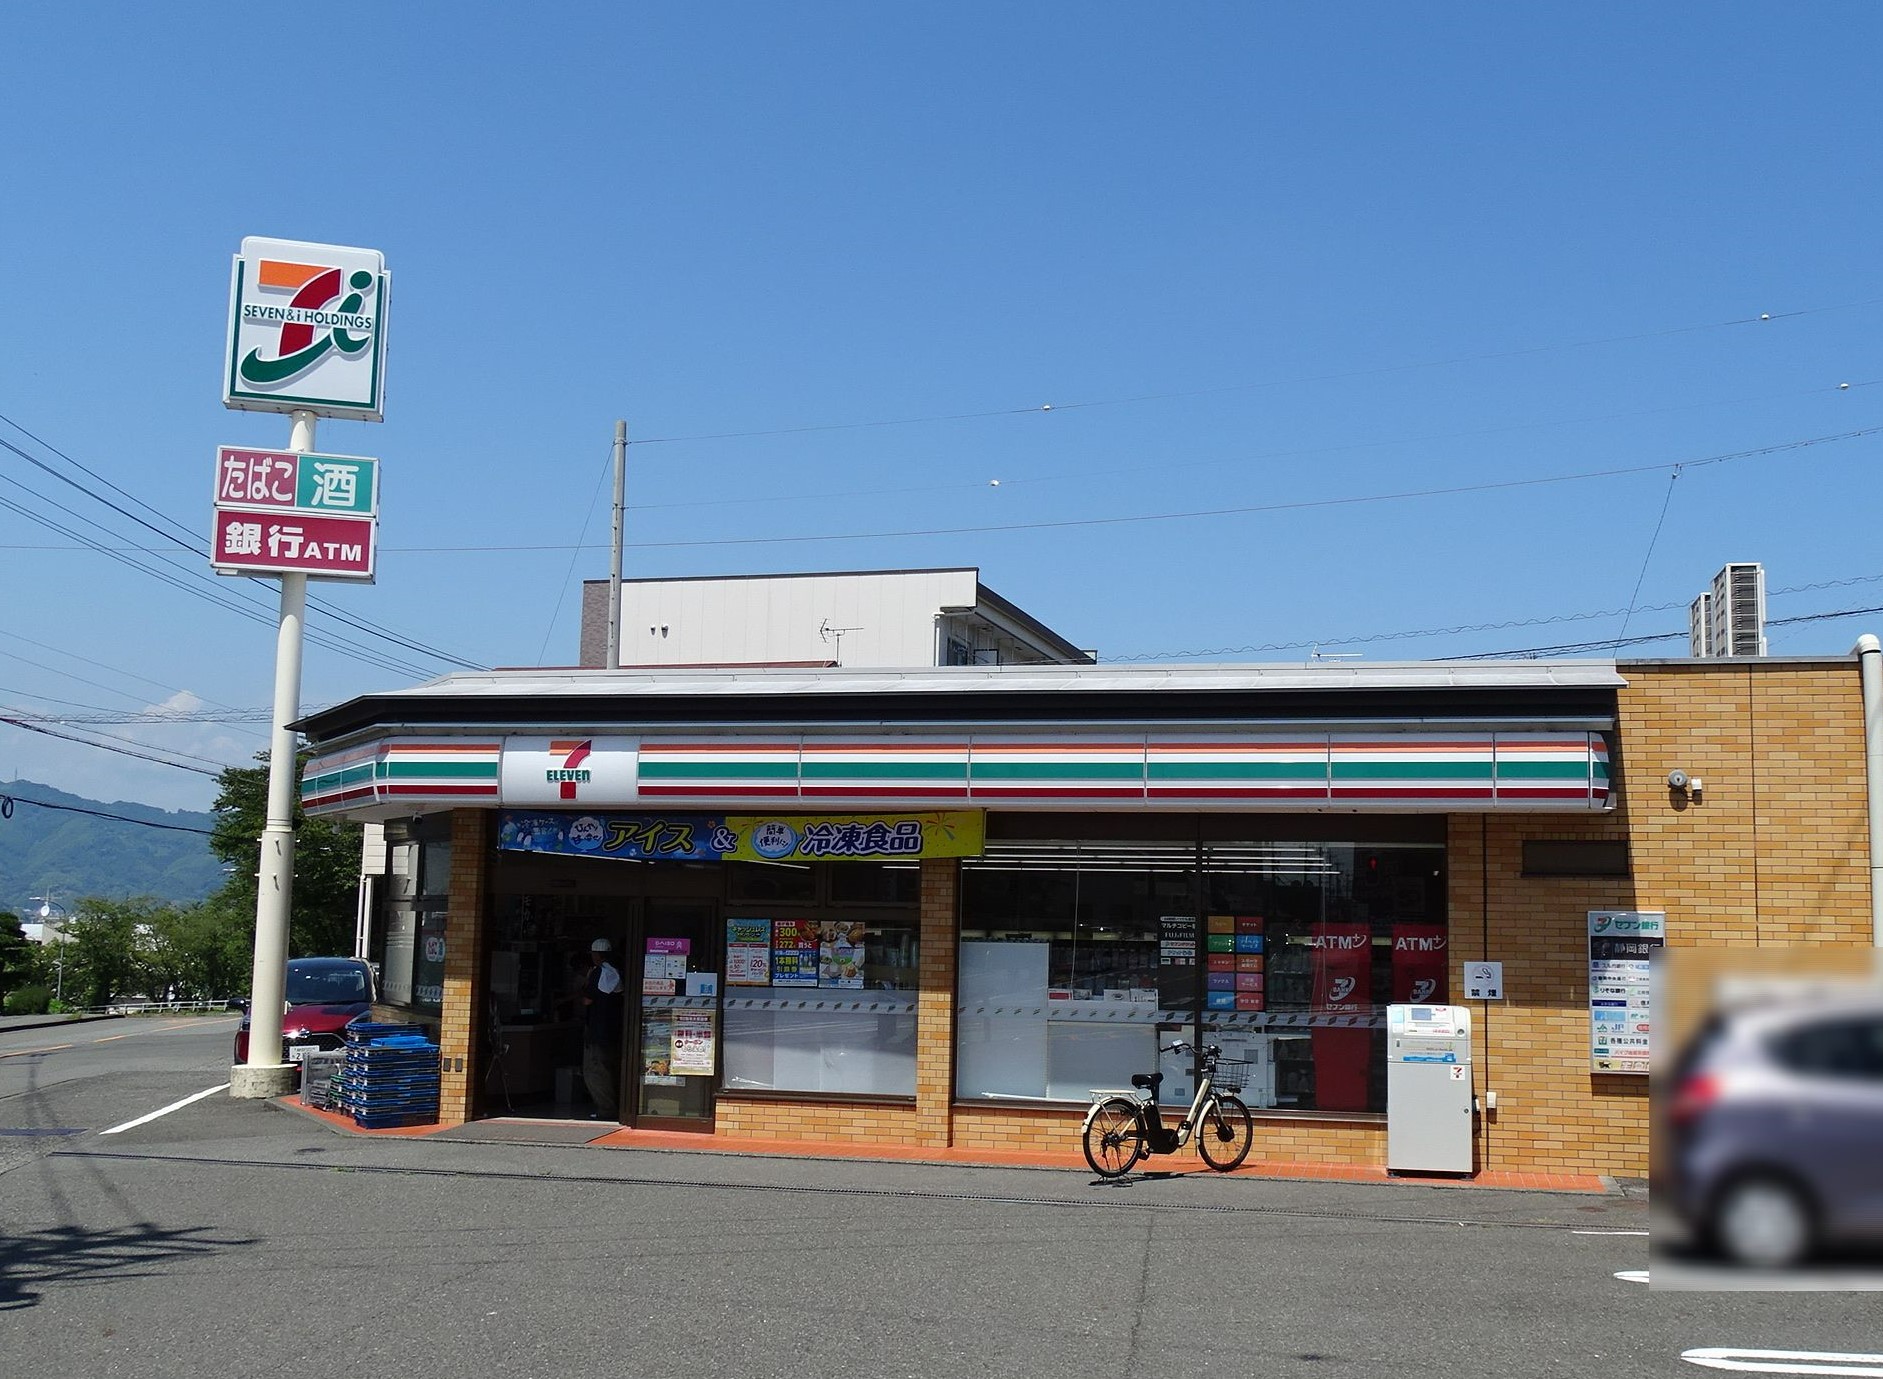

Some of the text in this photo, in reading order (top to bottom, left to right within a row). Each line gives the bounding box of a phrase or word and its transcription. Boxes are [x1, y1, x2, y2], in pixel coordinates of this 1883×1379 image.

[304, 310, 372, 329] HOLDINGS
[222, 455, 359, 507] たばこ 酒
[602, 819, 739, 856] アイス &
[765, 826, 786, 836] 簡単
[801, 820, 923, 856] 冷凍食品
[1614, 920, 1659, 930] セブン銀行
[1471, 988, 1497, 997] 禁煙
